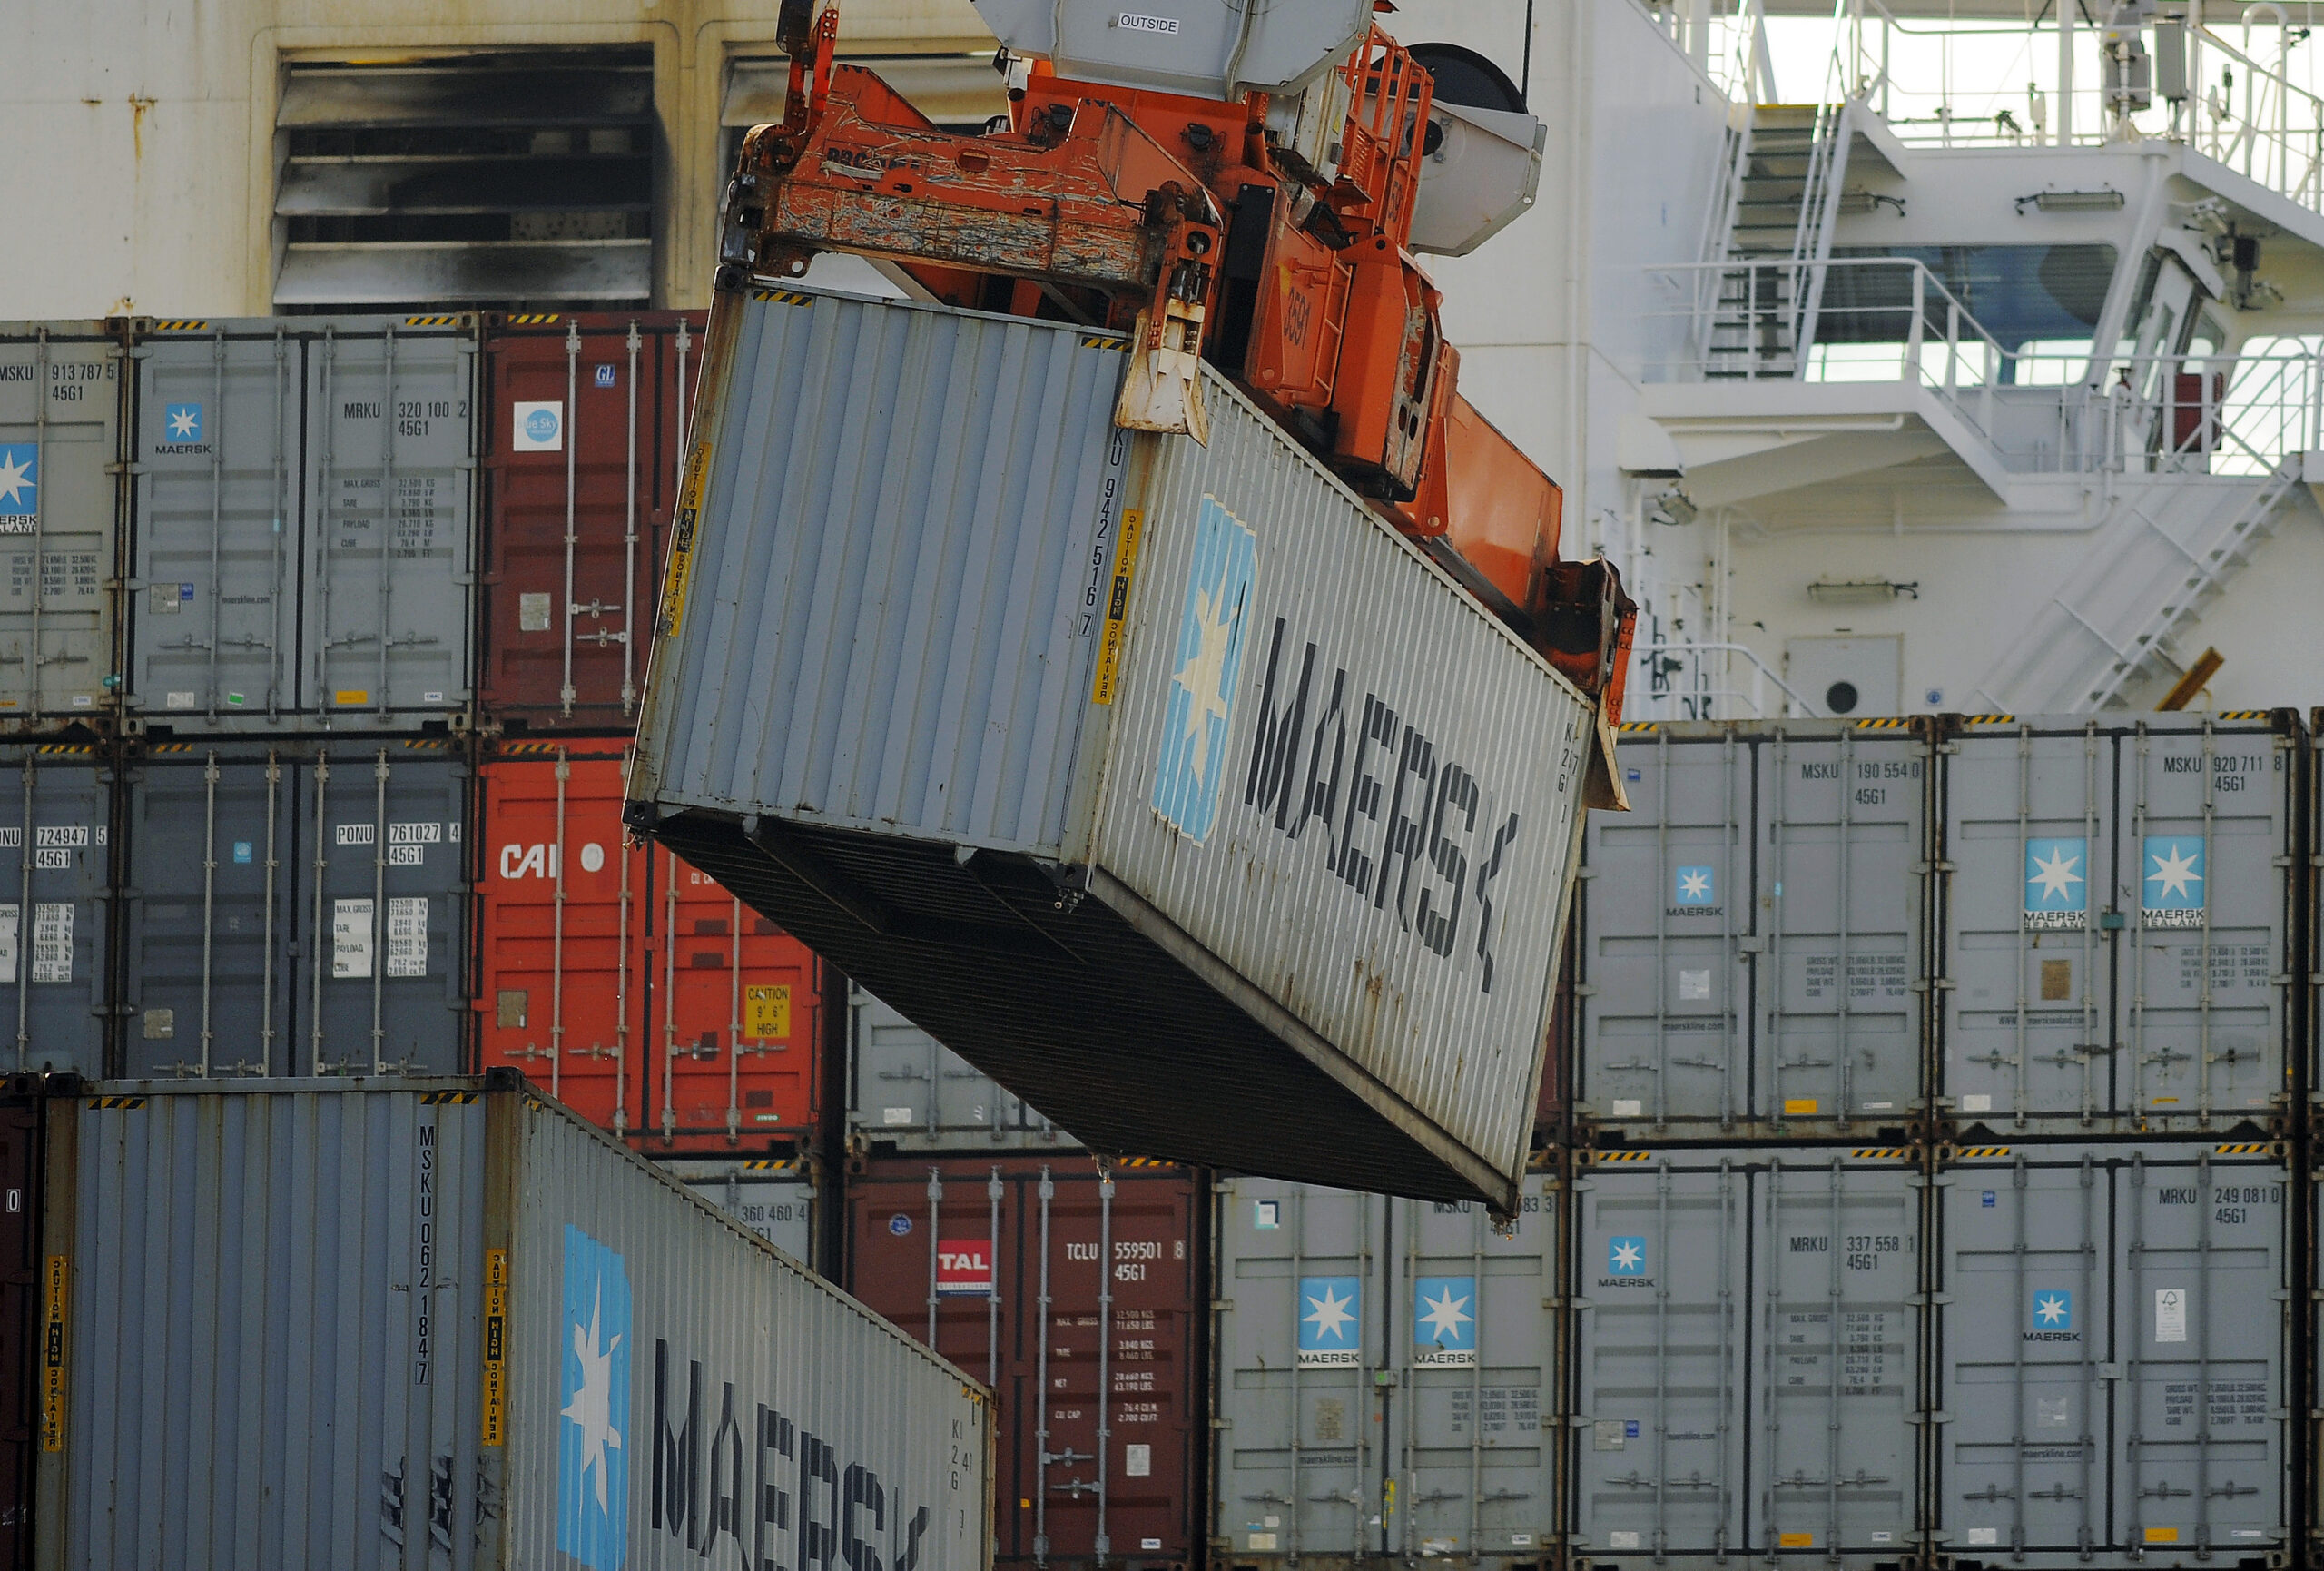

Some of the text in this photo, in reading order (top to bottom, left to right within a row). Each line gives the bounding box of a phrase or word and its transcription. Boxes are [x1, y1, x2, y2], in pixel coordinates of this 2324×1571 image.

[1120, 15, 1177, 33] OUTSIDE
[52, 364, 75, 380] 913
[80, 364, 102, 380] 787
[106, 365, 114, 379] 5
[597, 366, 615, 381] GL
[52, 385, 83, 400] 45G1
[343, 402, 467, 419] MRKU 320 100 2
[398, 420, 429, 436] 45G1
[539, 418, 557, 431] Sky
[155, 444, 212, 455] MAERSK
[0, 515, 36, 525] ERSK
[1081, 428, 1124, 635] KU 942 516 7
[1801, 763, 1919, 779] MSKU 190 554 0
[2164, 756, 2282, 773] MSKU 920 711 8
[2215, 776, 2245, 791] 45G1
[1855, 788, 1886, 804] 45G1
[1245, 616, 1519, 994] MAERSK
[0, 827, 105, 845] NU 724947 5
[339, 825, 458, 842] PONU 761027 4
[38, 851, 69, 866] 45G1
[391, 847, 423, 863] 45G1
[500, 844, 556, 879] CAI
[1666, 907, 1723, 916] MAERSK
[2024, 912, 2085, 922] MAERSK
[2142, 909, 2204, 919] MAERSK
[336, 924, 350, 933] TARE
[748, 987, 788, 1000] CAUTION
[756, 1023, 778, 1035] HIGH
[9, 1190, 18, 1211] 0
[2159, 1187, 2279, 1204] MRKU 249 081 0
[1521, 1197, 1539, 1212] 83
[1545, 1196, 1553, 1212] 3
[742, 1205, 806, 1221] 360 460 4
[2215, 1208, 2247, 1223] 45G1
[1066, 1240, 1184, 1260] TCLU 559501 8
[1789, 1236, 1828, 1252] MRKU
[1847, 1236, 1870, 1252] 337
[1876, 1236, 1899, 1252] 558
[418, 1126, 435, 1384] MSKU 062 184 7
[939, 1253, 989, 1270] TAL
[1847, 1254, 1878, 1270] 45G1
[1114, 1263, 1146, 1281] 45G1
[1598, 1278, 1656, 1288] MAERSK
[2023, 1332, 2082, 1342] MAERSK
[1298, 1353, 1360, 1364] MAERSK
[1414, 1353, 1476, 1364] MAERSK
